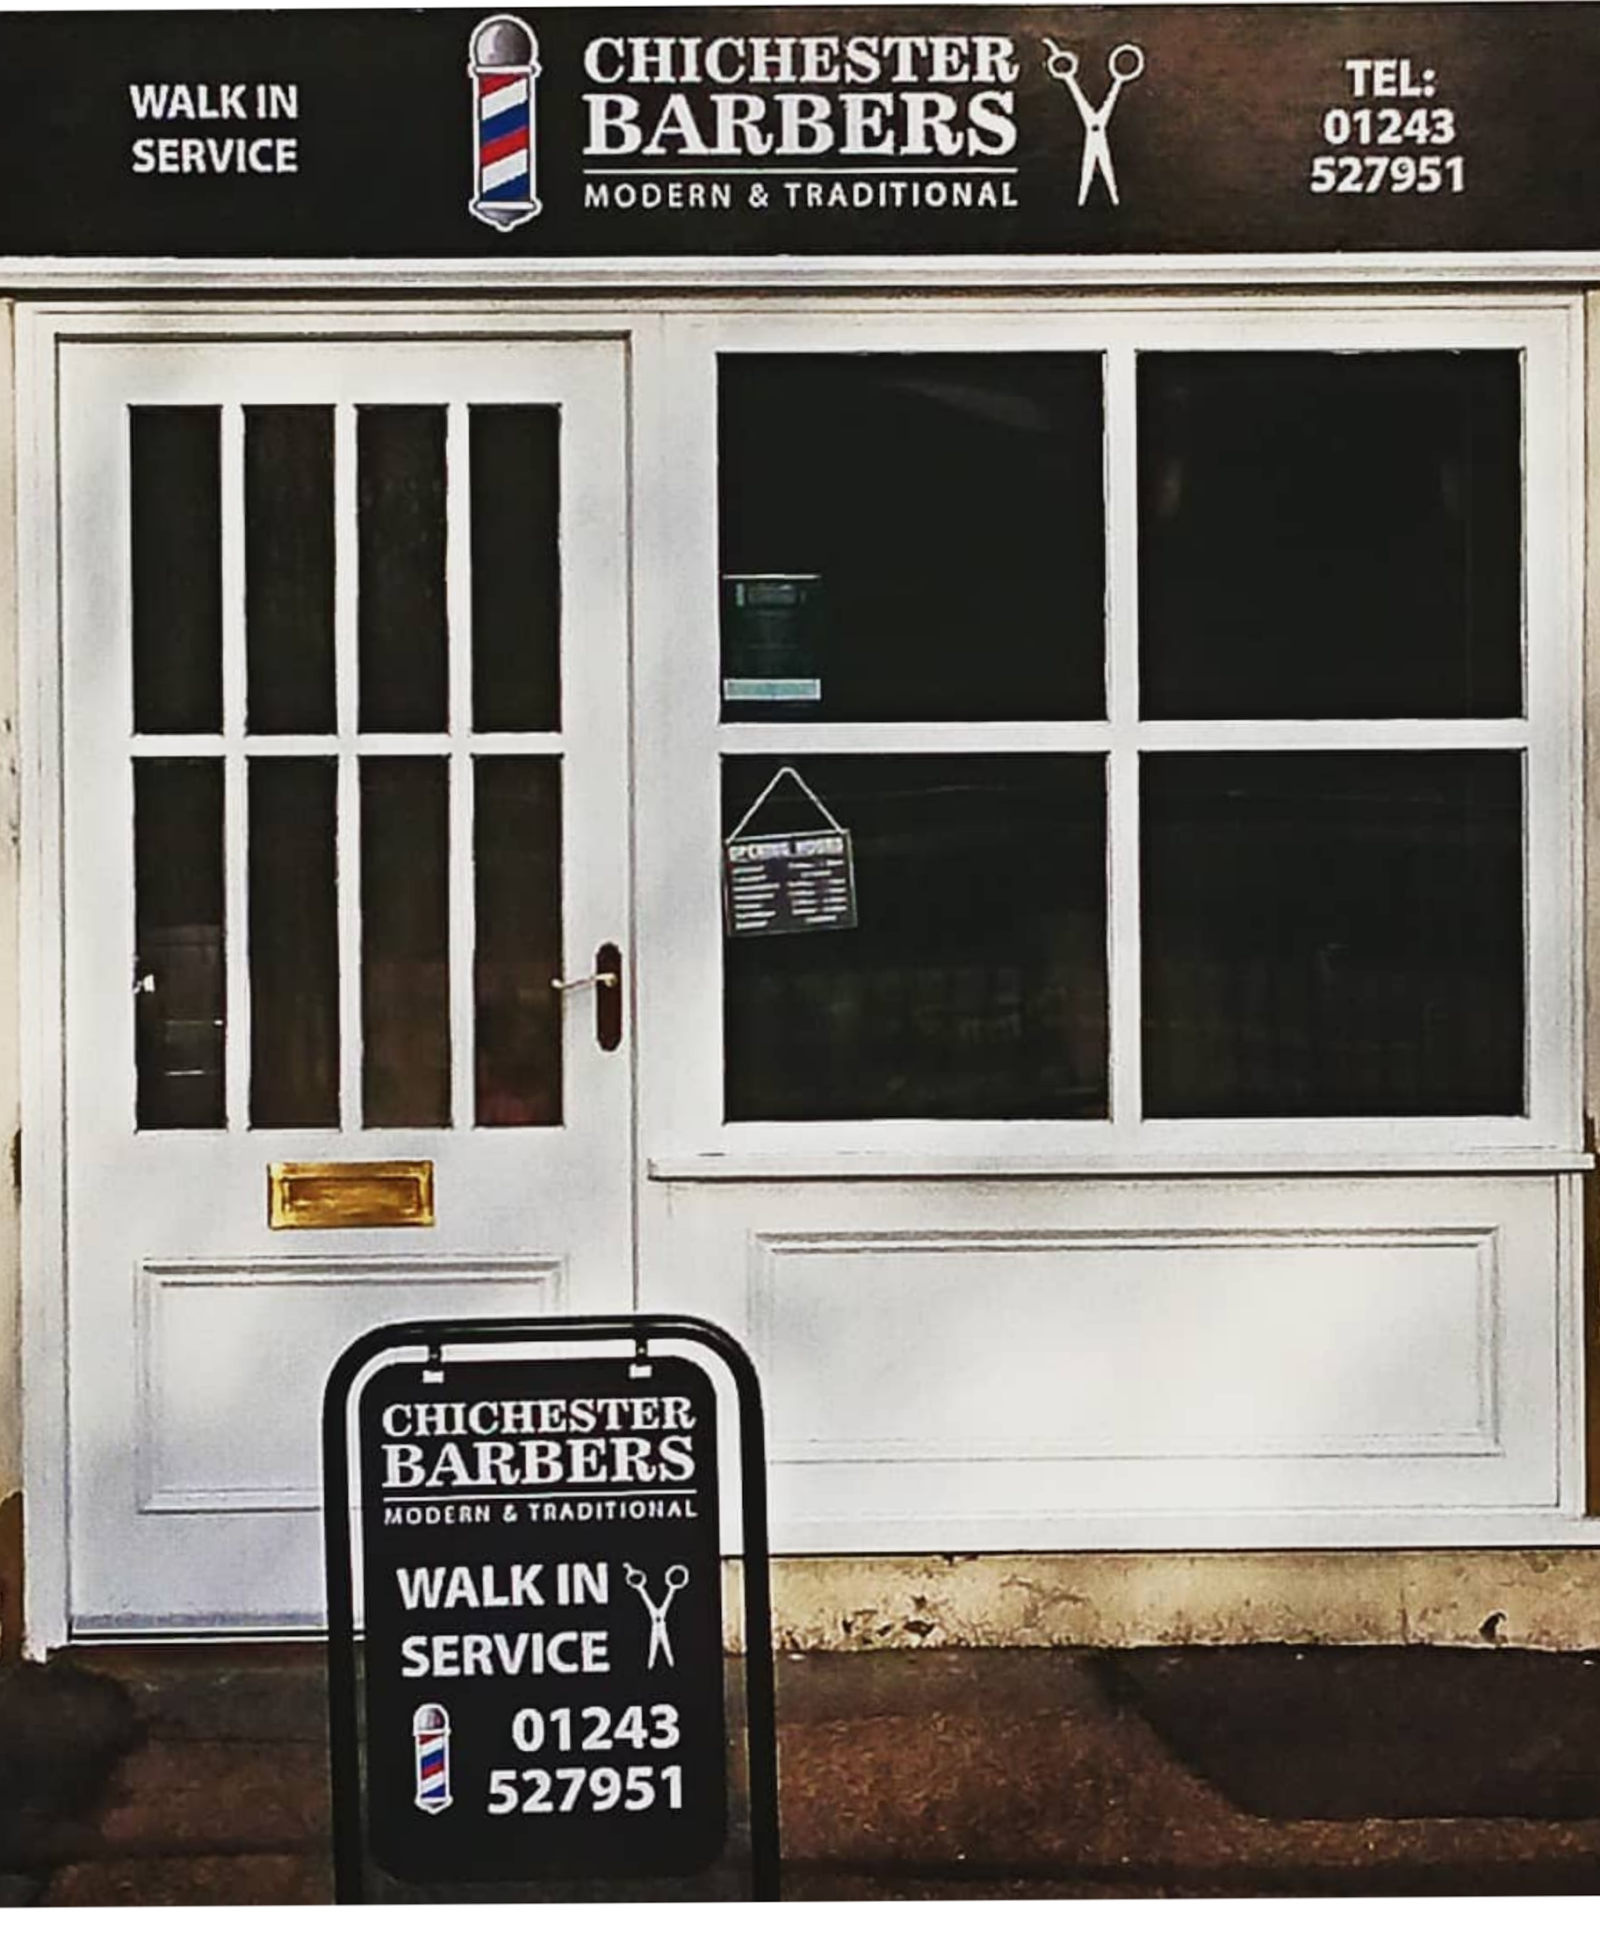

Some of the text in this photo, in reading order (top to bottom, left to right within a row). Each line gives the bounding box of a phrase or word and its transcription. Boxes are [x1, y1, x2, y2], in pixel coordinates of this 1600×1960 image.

[584, 35, 1019, 84] CHICHESTER
[1345, 59, 1436, 98] TEL:
[129, 84, 298, 120] WALK IN
[582, 91, 1017, 157] BARBERS
[1323, 107, 1456, 145] 01243
[132, 138, 298, 174] SERVICE
[1310, 155, 1464, 193] 527951
[584, 181, 1018, 209] MODERN & TRADITIONAL
[382, 1396, 696, 1438] CHICHESTER
[381, 1435, 696, 1490] BARBERS
[384, 1498, 698, 1525] MODERN & TRADITIONAL
[395, 1562, 609, 1610] WALK IN
[401, 1630, 611, 1678] SERVICE
[512, 1703, 680, 1752] 01243
[487, 1765, 682, 1815] 527951
